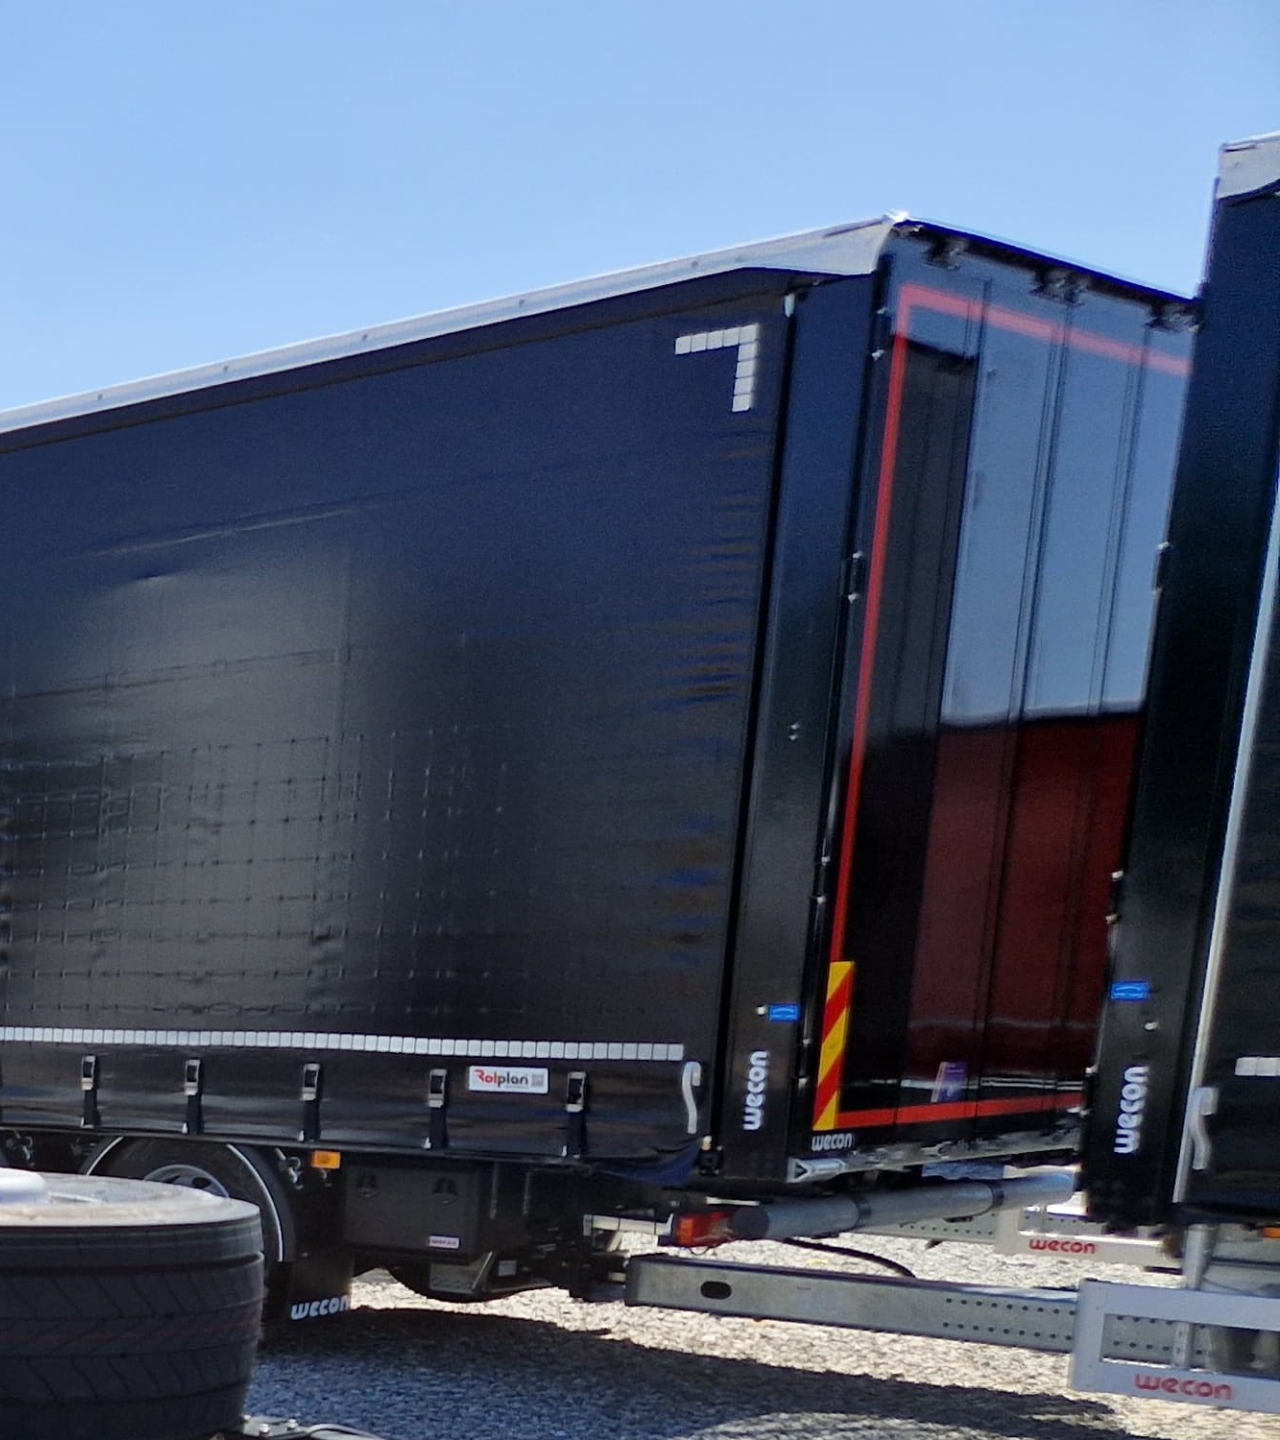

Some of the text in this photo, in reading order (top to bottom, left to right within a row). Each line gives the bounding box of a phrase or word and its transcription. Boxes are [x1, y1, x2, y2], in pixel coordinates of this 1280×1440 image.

[743, 1050, 769, 1131] wecon
[1112, 1066, 1150, 1154] wecon
[812, 1132, 854, 1152] wecon
[1029, 1238, 1097, 1254] wecon
[1134, 1372, 1234, 1400] wecon
